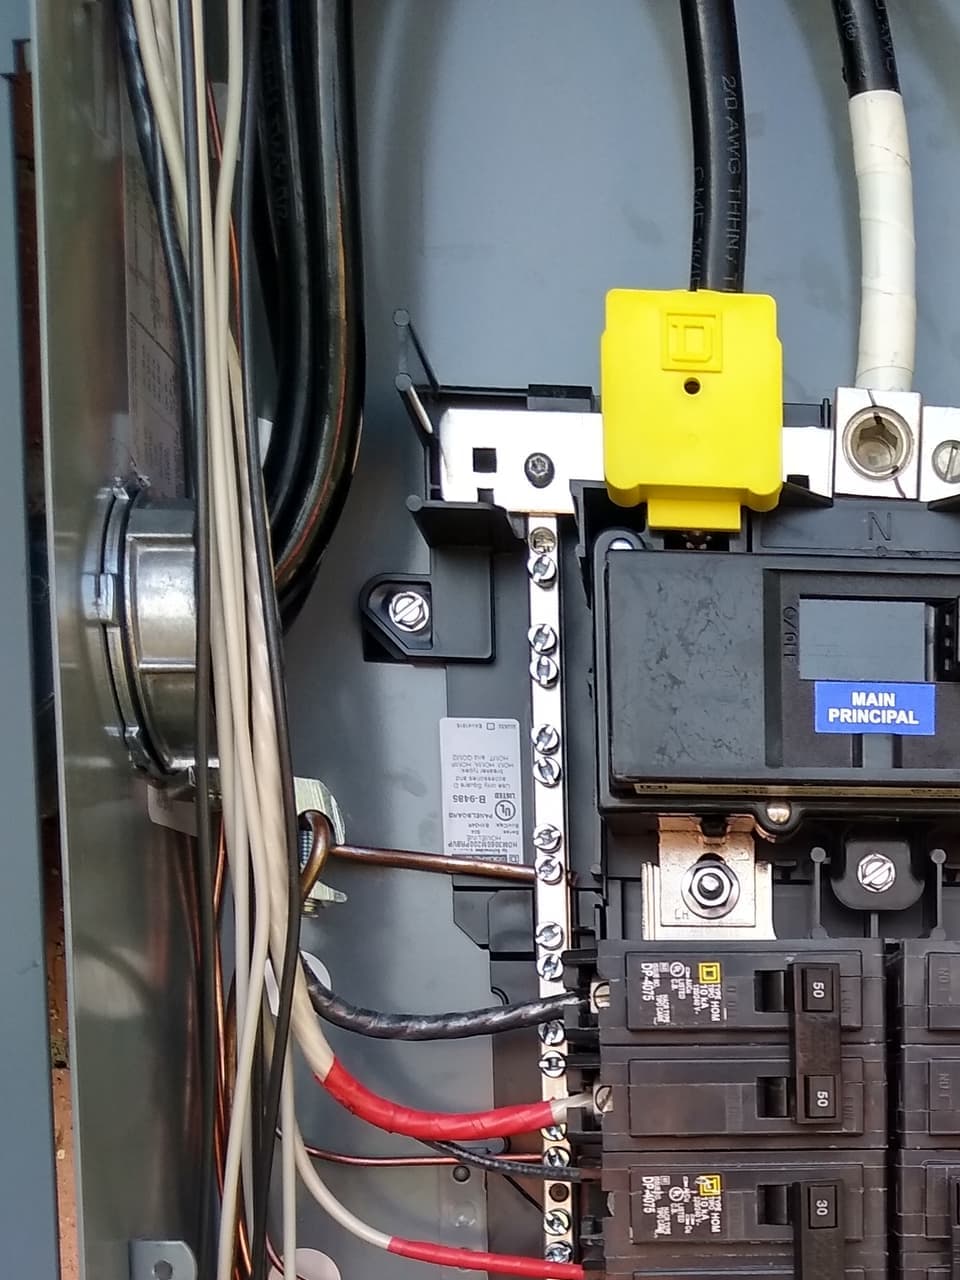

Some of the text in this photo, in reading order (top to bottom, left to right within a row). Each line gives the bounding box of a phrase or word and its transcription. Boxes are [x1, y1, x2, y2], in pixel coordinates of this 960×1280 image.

[727, 116, 741, 174] AWG
[727, 185, 741, 249] THHN
[868, 512, 892, 540] N
[852, 692, 895, 707] MAIN
[828, 709, 919, 724] PRINCIPAL
[453, 795, 486, 803] B-9485
[641, 963, 654, 1001] DP-4075
[812, 981, 825, 998] 50
[711, 1001, 720, 1021] HOM
[817, 1090, 829, 1107] 50
[642, 1177, 656, 1213] DP-4075
[816, 1199, 828, 1216] 30
[711, 1213, 720, 1232] HOM
